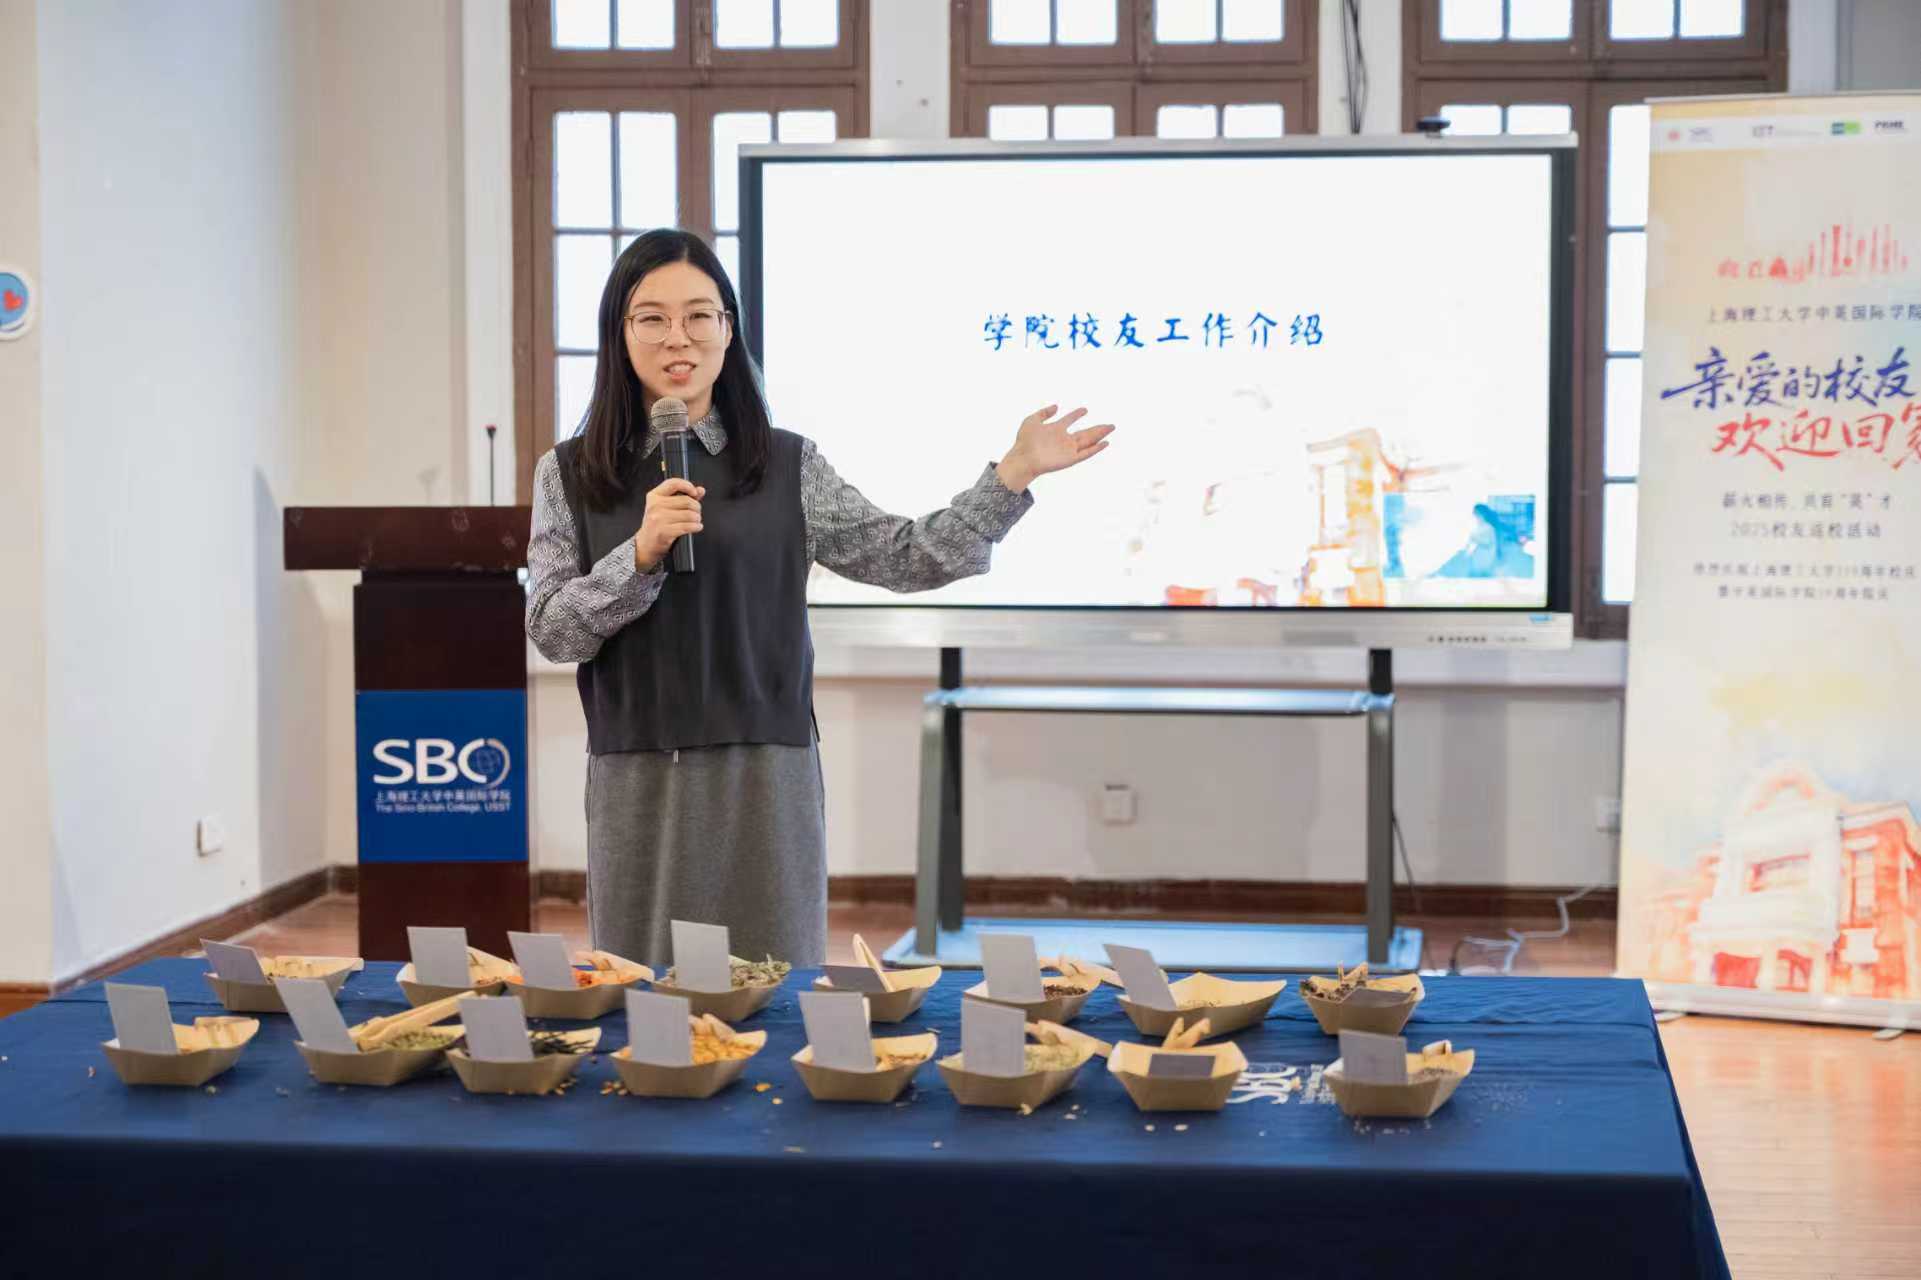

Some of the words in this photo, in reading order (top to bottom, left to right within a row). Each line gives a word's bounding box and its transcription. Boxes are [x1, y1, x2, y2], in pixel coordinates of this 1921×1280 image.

[984, 312, 1324, 351] 学院校友工作介绍
[1660, 346, 1916, 410] 亲爱的校友
[373, 738, 511, 787] SBC
